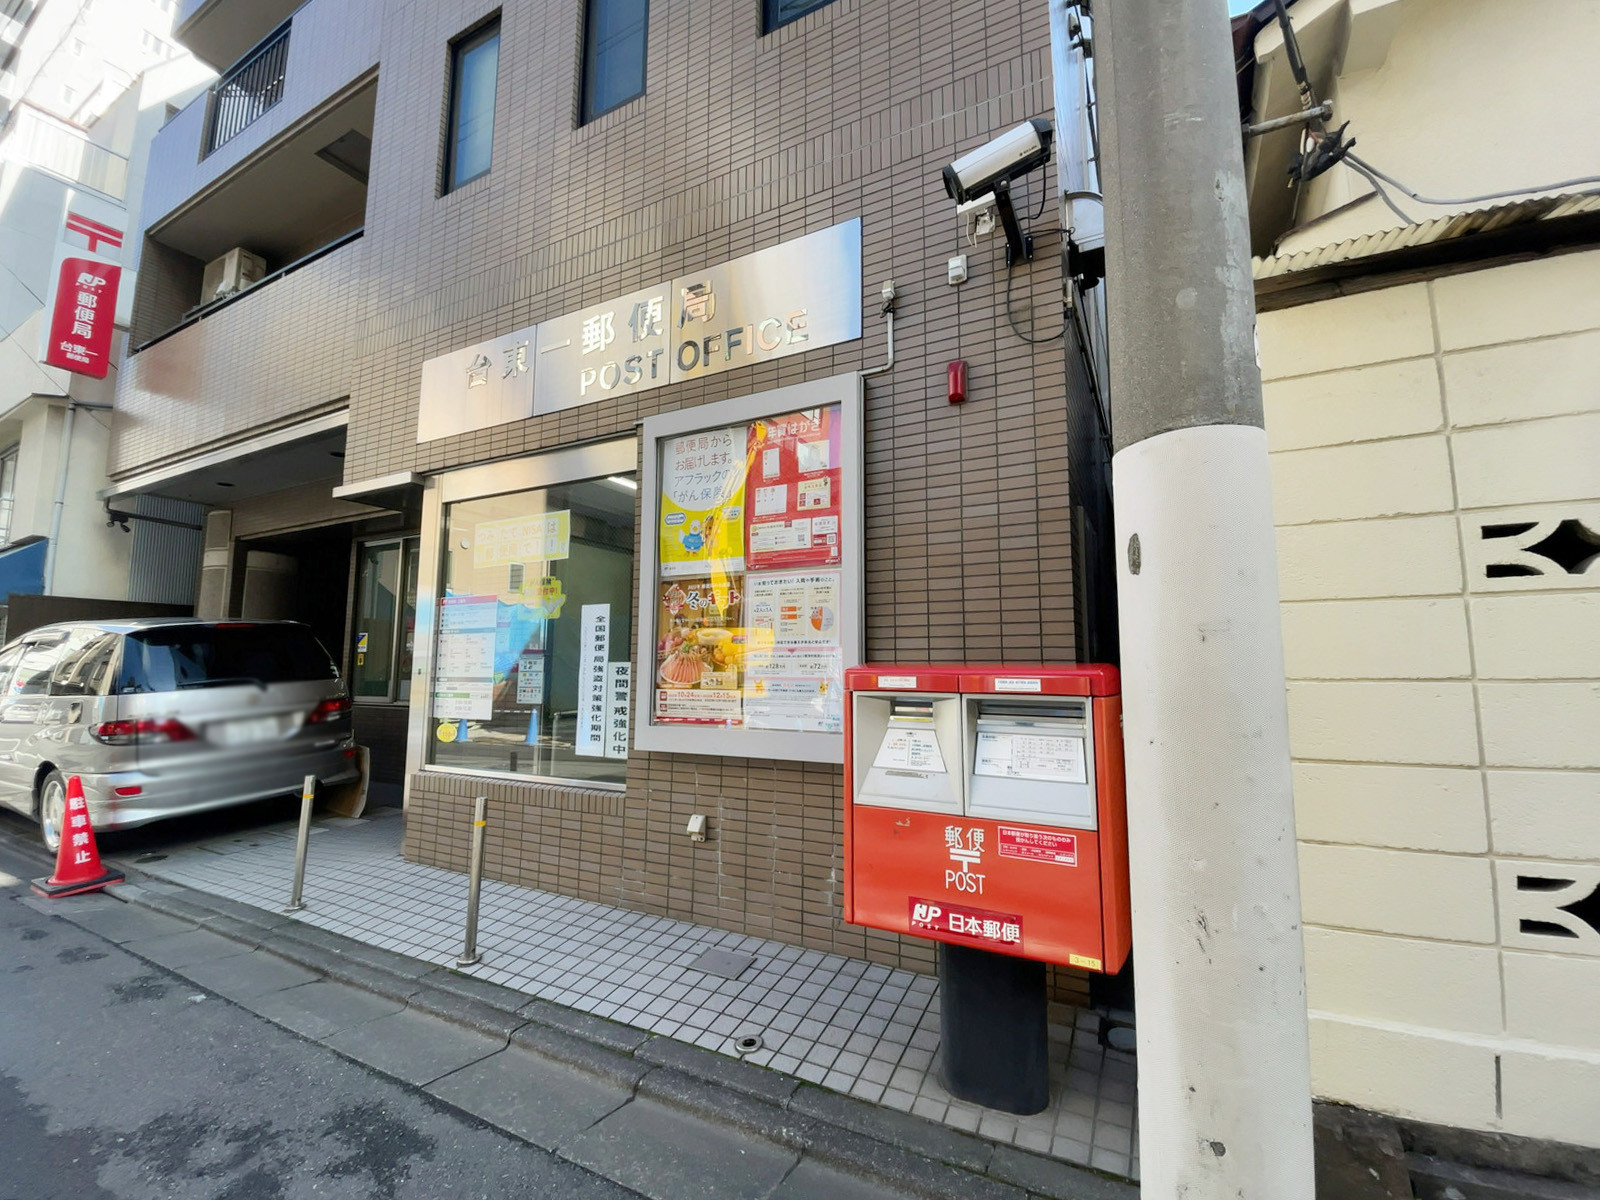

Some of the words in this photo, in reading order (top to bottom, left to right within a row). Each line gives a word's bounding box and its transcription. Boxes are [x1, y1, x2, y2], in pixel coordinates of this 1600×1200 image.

[71, 291, 98, 339] 郵便局
[60, 340, 98, 356] 台東一
[580, 347, 664, 397] POST
[677, 308, 809, 372] OFFICE
[767, 418, 821, 439] 年賀はがき
[674, 434, 732, 455] 郵便局から
[675, 452, 733, 471] お届けします。
[674, 469, 730, 488] アフラックの
[590, 615, 606, 742] 全国郵便局強盗対策強化期間
[612, 666, 629, 754] 夜間警戒強化中
[69, 796, 91, 864] 駐車禁止
[944, 825, 985, 853] 郵便
[945, 870, 986, 895] POST
[911, 920, 940, 931] POST
[948, 912, 1021, 943] 日本郵便
